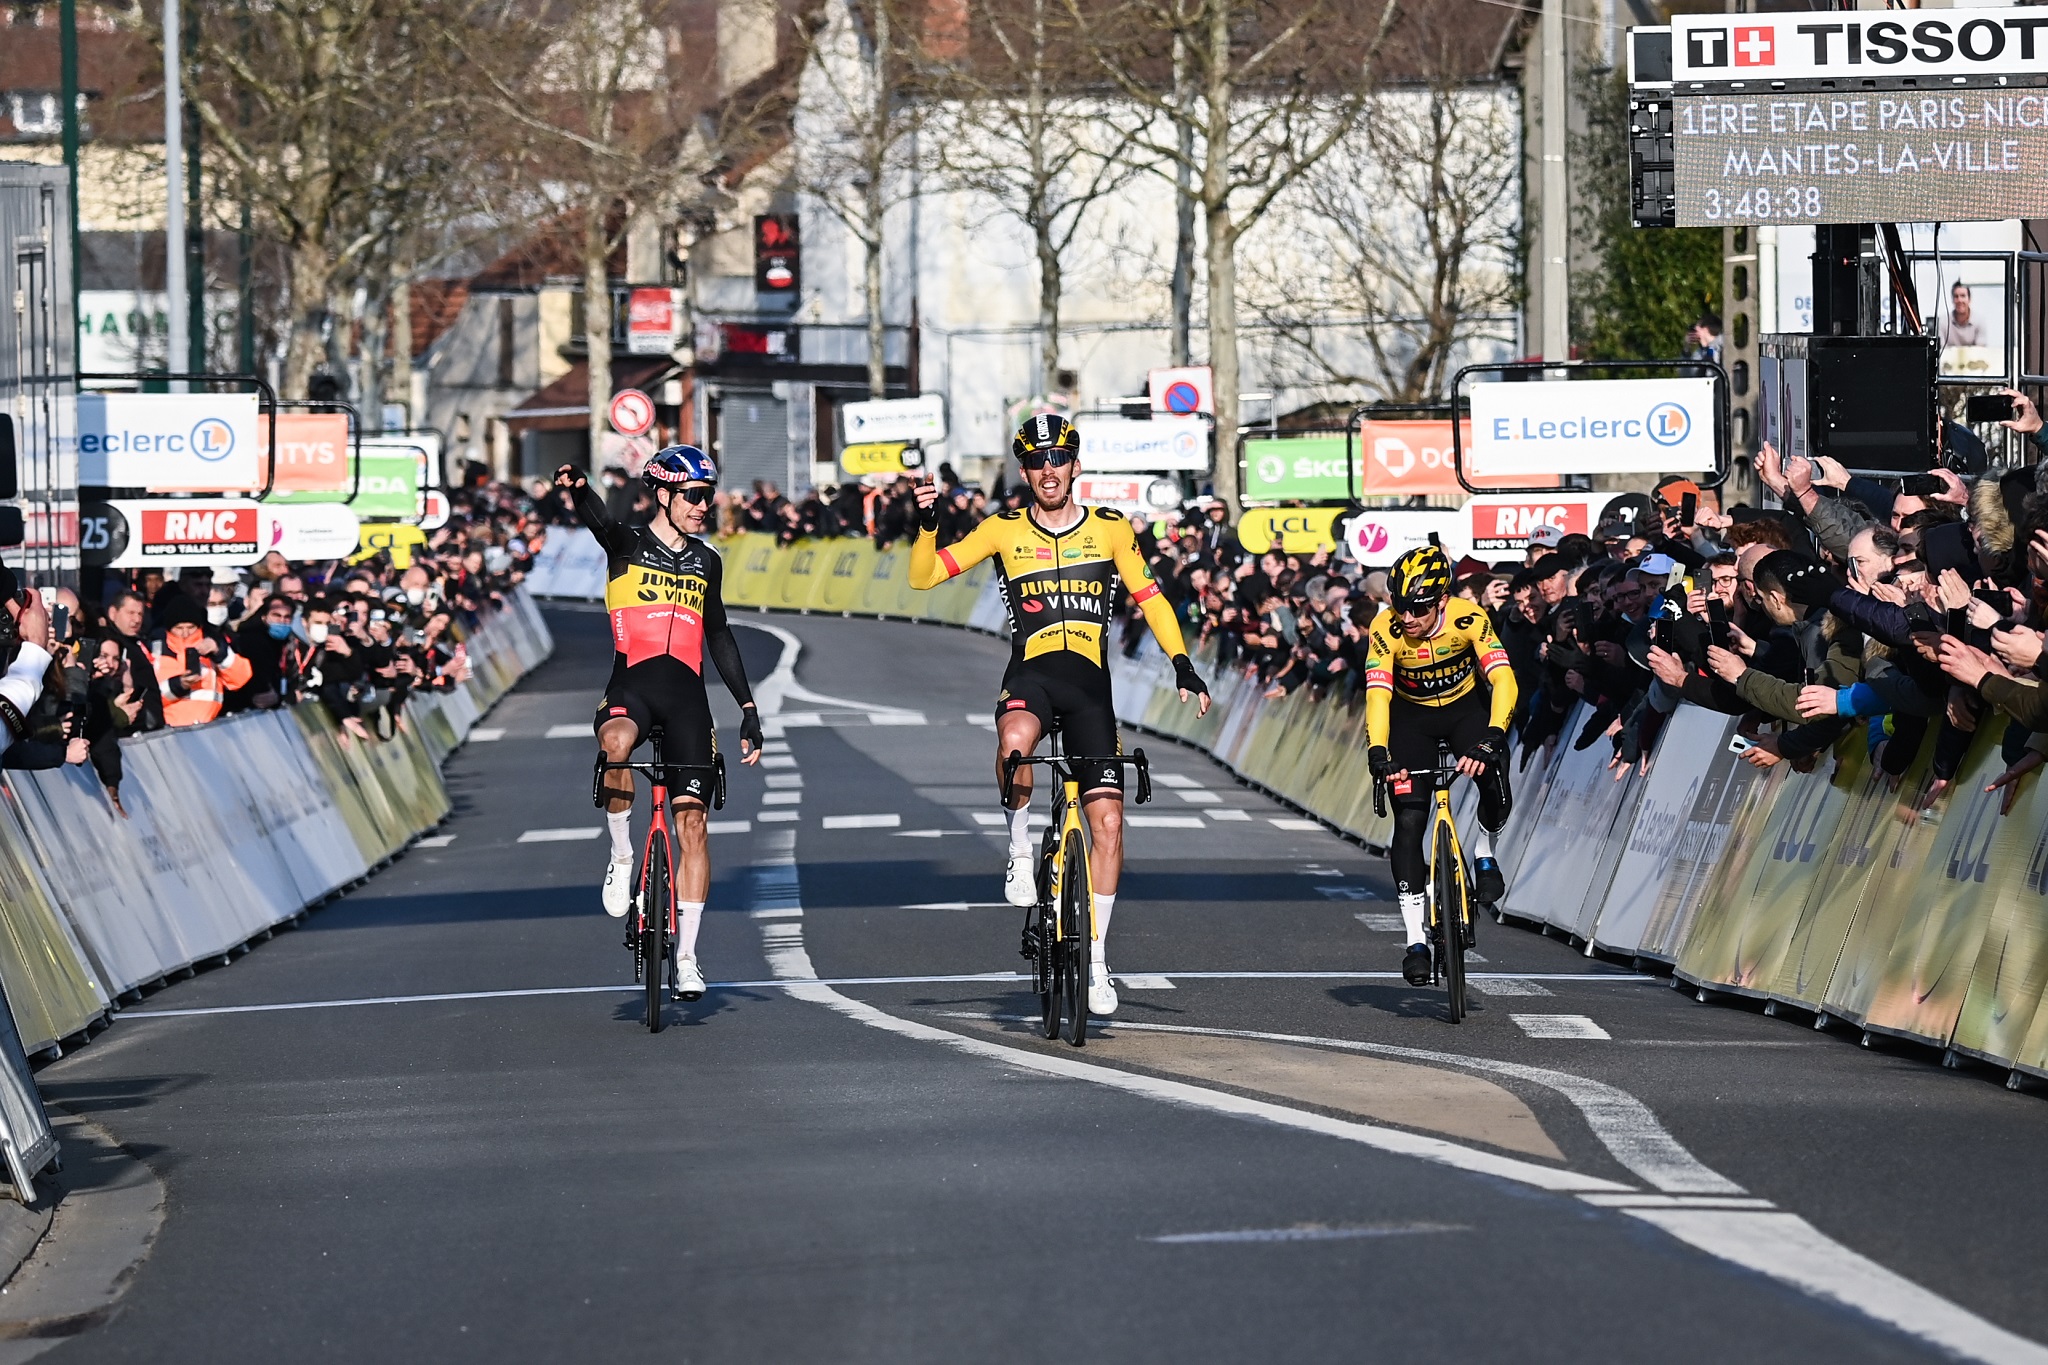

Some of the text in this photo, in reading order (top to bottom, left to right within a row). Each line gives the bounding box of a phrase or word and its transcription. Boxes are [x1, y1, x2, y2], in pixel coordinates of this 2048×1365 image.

[1797, 17, 2048, 66] TISSOT
[1770, 101, 1868, 134] ETAPE
[1723, 140, 2020, 177] MANTES-LA-VILLE
[1704, 186, 1822, 220] 3:48:38
[1493, 416, 1641, 441] E.Leclerc
[80, 431, 184, 453] eclerc
[164, 511, 238, 541] RMC
[1269, 517, 1316, 534] LCL
[1495, 506, 1569, 535] RMC
[145, 543, 256, 554] INFO TALK SPORT
[367, 533, 405, 549] CL
[1477, 540, 1507, 549] INFO
[639, 572, 706, 596] JUMBO
[1020, 579, 1103, 598] JUMBO
[1149, 583, 1160, 595] HE
[664, 590, 703, 613] VISMA
[998, 574, 1018, 634] HEMA
[1046, 595, 1102, 616] VISMA
[615, 609, 624, 641] HEMA
[1040, 628, 1093, 642] cervélo
[1400, 656, 1472, 681] JUMBO
